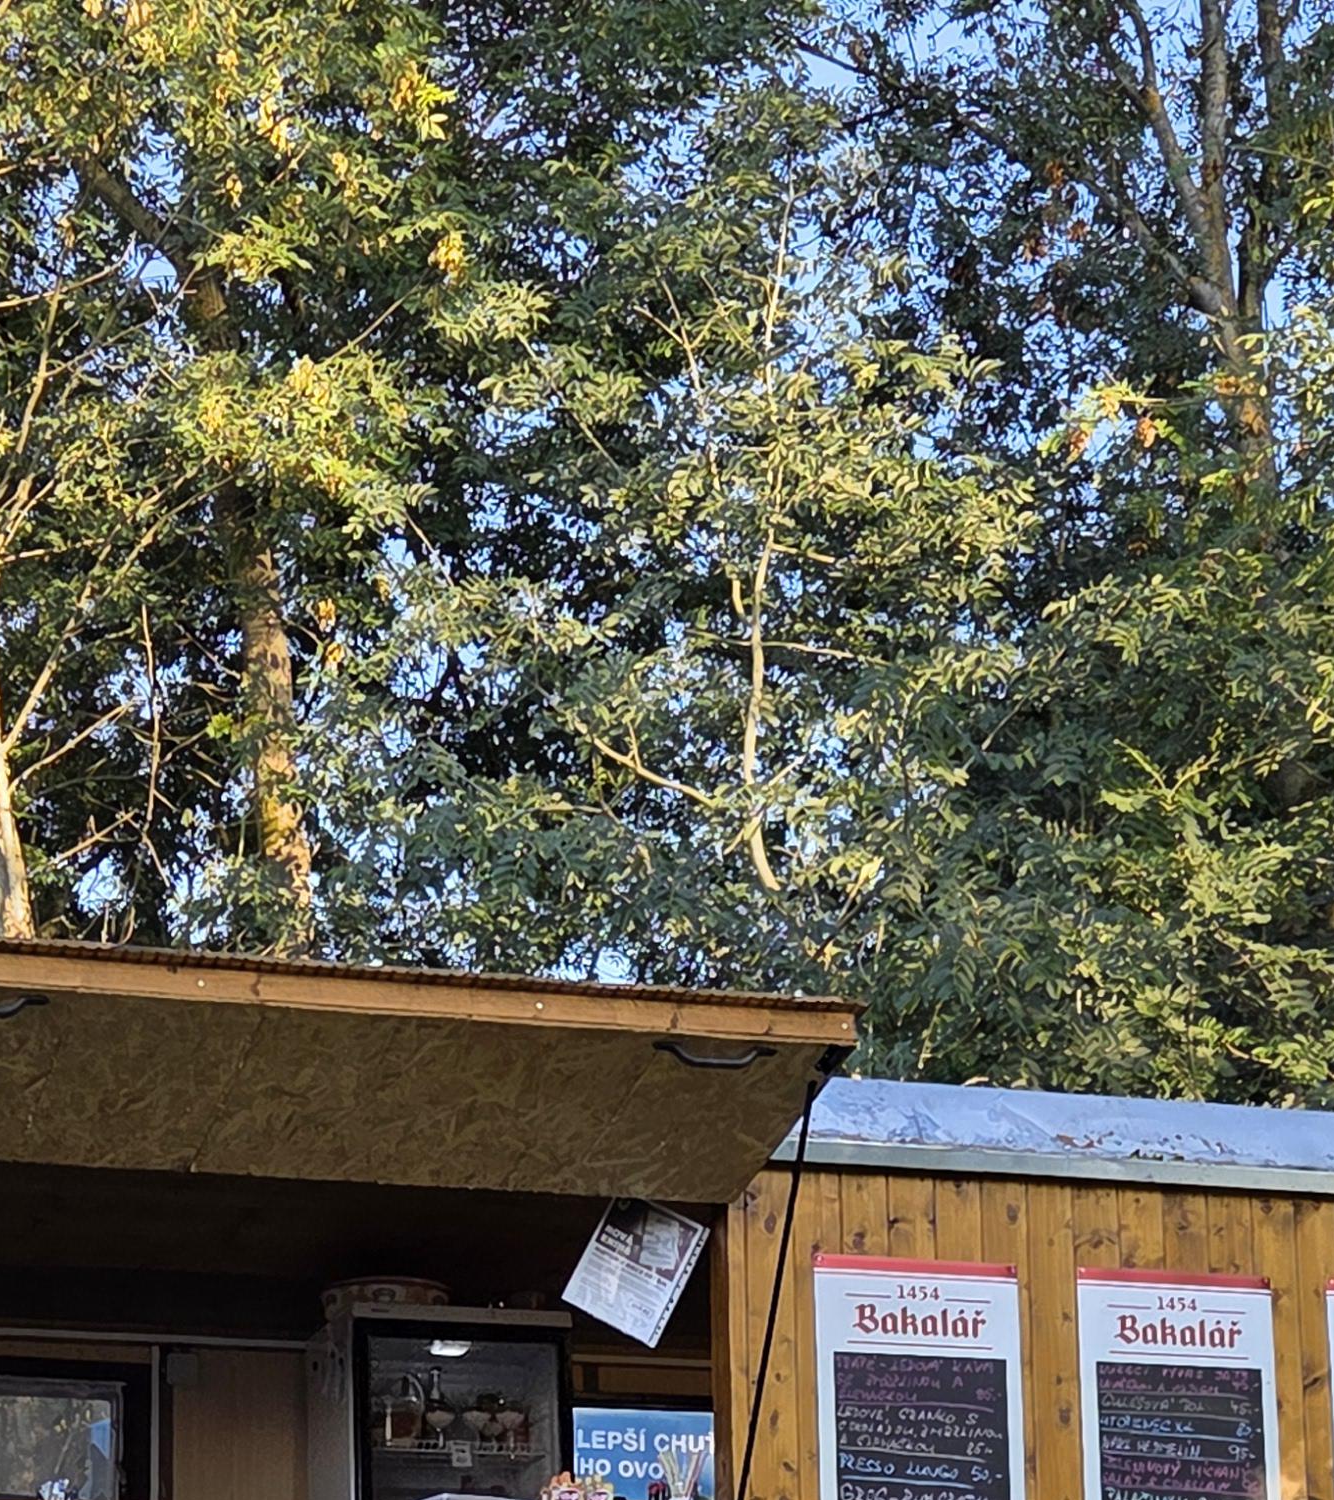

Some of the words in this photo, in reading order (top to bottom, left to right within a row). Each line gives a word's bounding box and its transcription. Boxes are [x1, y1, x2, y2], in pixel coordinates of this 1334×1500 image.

[896, 1284, 940, 1300] 1454
[1156, 1296, 1198, 1312] 1454
[852, 1303, 987, 1339] Bakalář
[1114, 1315, 1242, 1349] Bakalář
